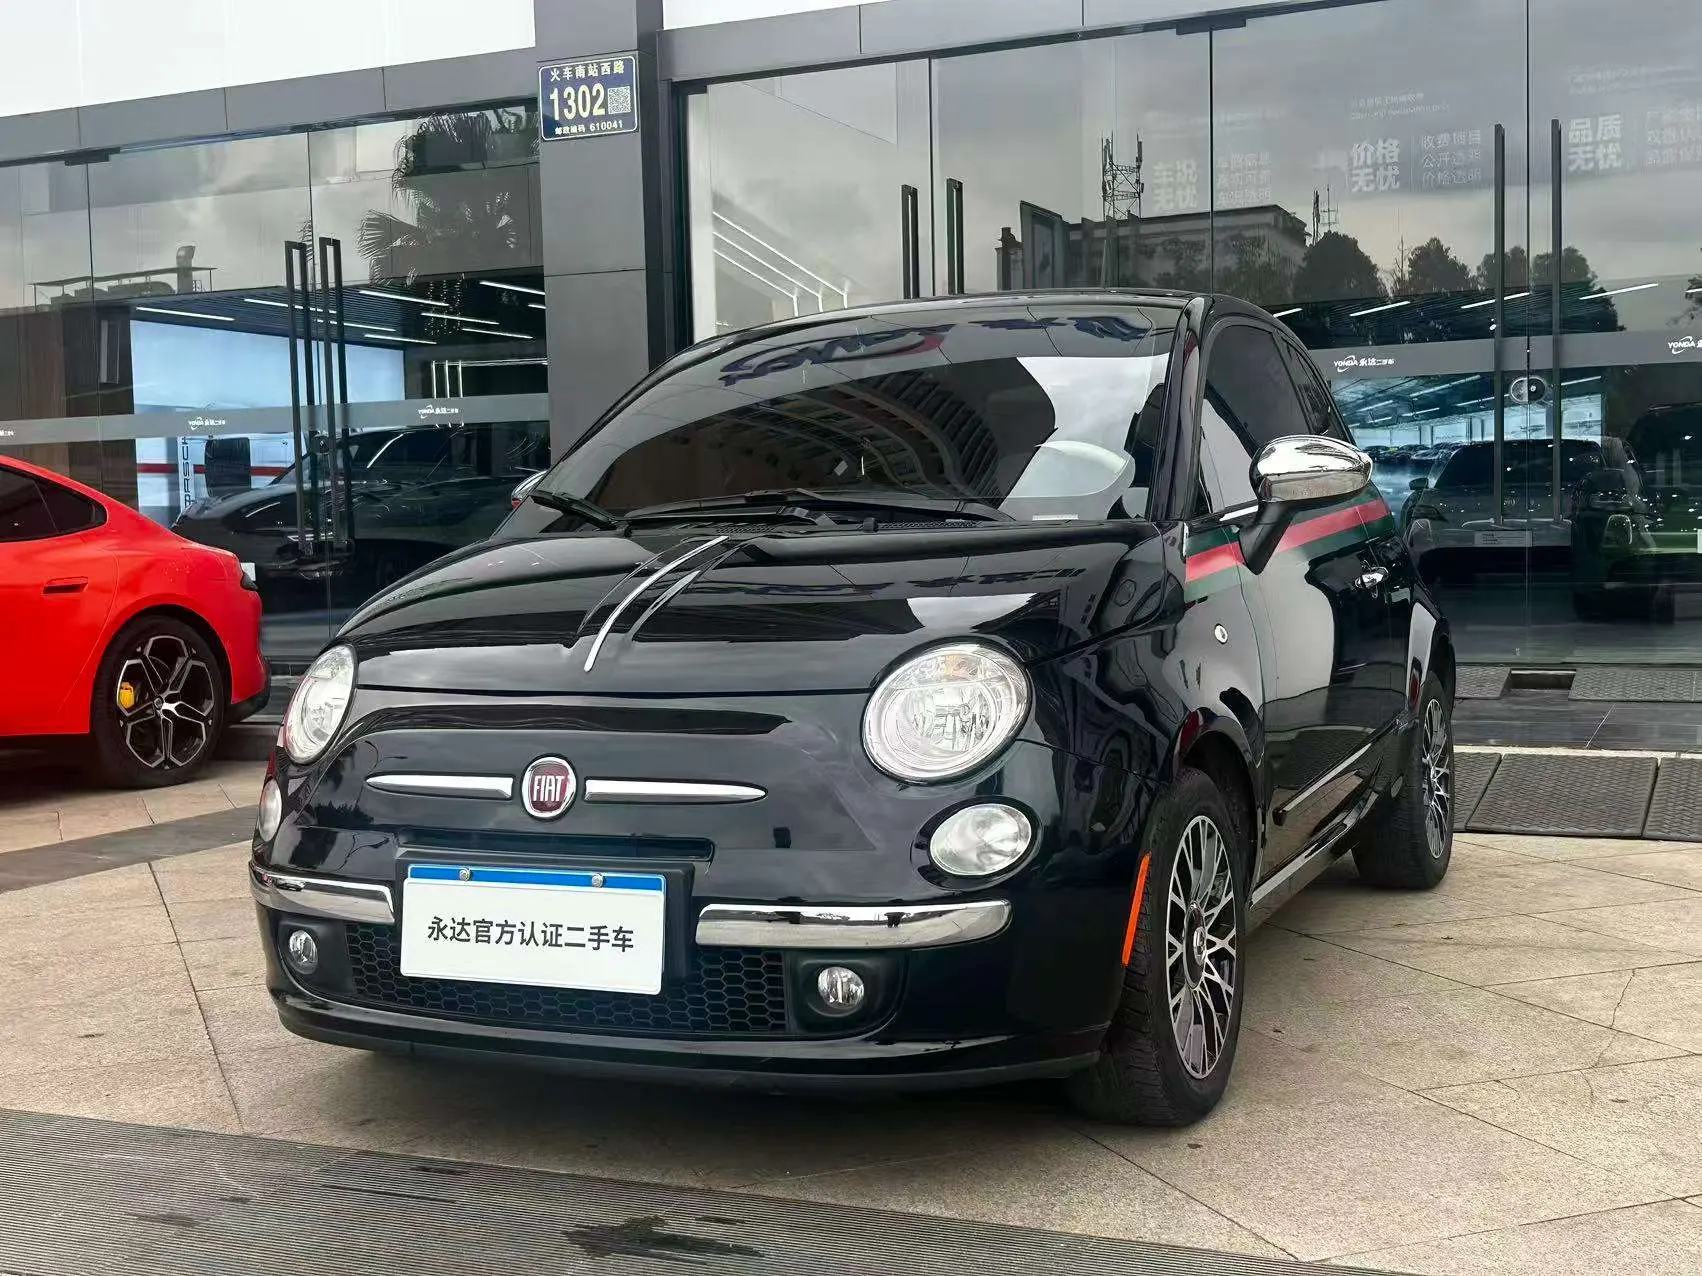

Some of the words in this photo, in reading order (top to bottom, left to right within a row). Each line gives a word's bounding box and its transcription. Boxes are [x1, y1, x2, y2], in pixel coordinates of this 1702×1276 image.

[550, 60, 625, 82] 火车南站西路
[549, 82, 606, 121] 1302
[589, 119, 624, 132] 610041
[1352, 138, 1400, 167] 价格
[1351, 165, 1400, 193] 无忧
[533, 774, 566, 802] FIAT
[427, 915, 634, 953] 永达官方认证二手车
